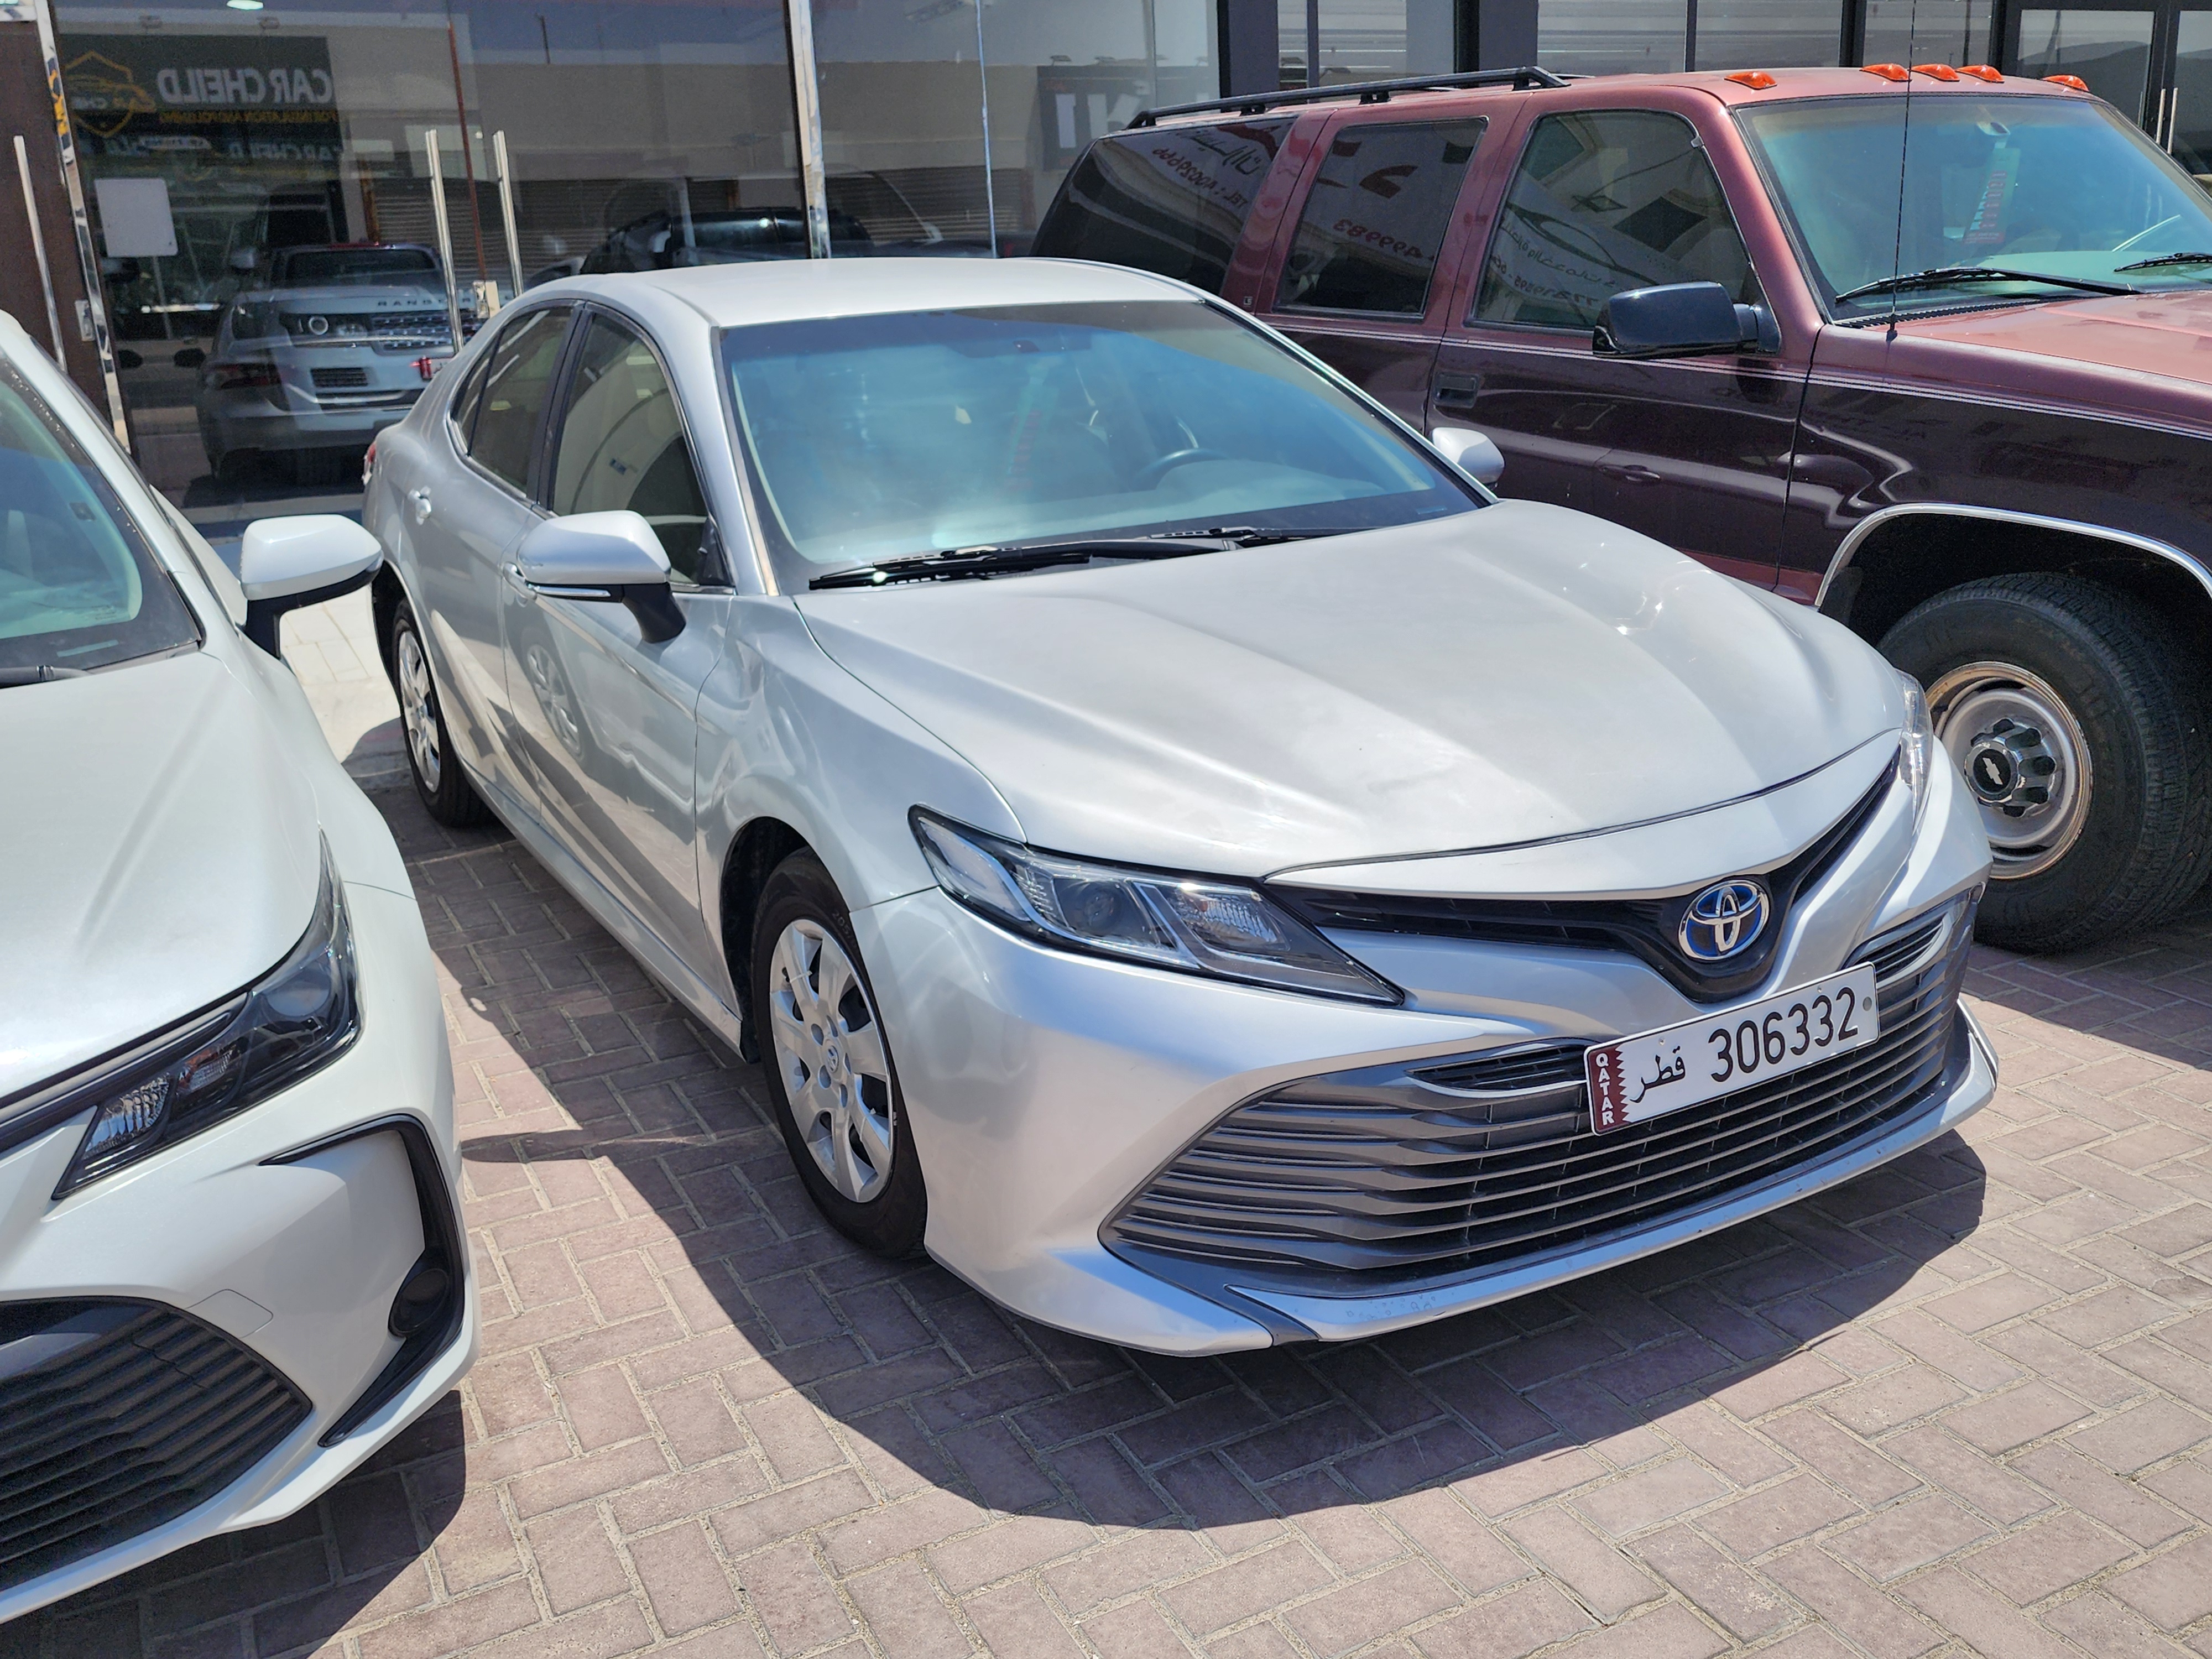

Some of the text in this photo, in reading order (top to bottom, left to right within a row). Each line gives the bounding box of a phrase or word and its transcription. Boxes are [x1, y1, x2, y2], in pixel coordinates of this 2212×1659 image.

[1708, 987, 1859, 1083] 306332
[1595, 1052, 1615, 1126] QATAR
[1629, 1045, 1686, 1104] قطر
